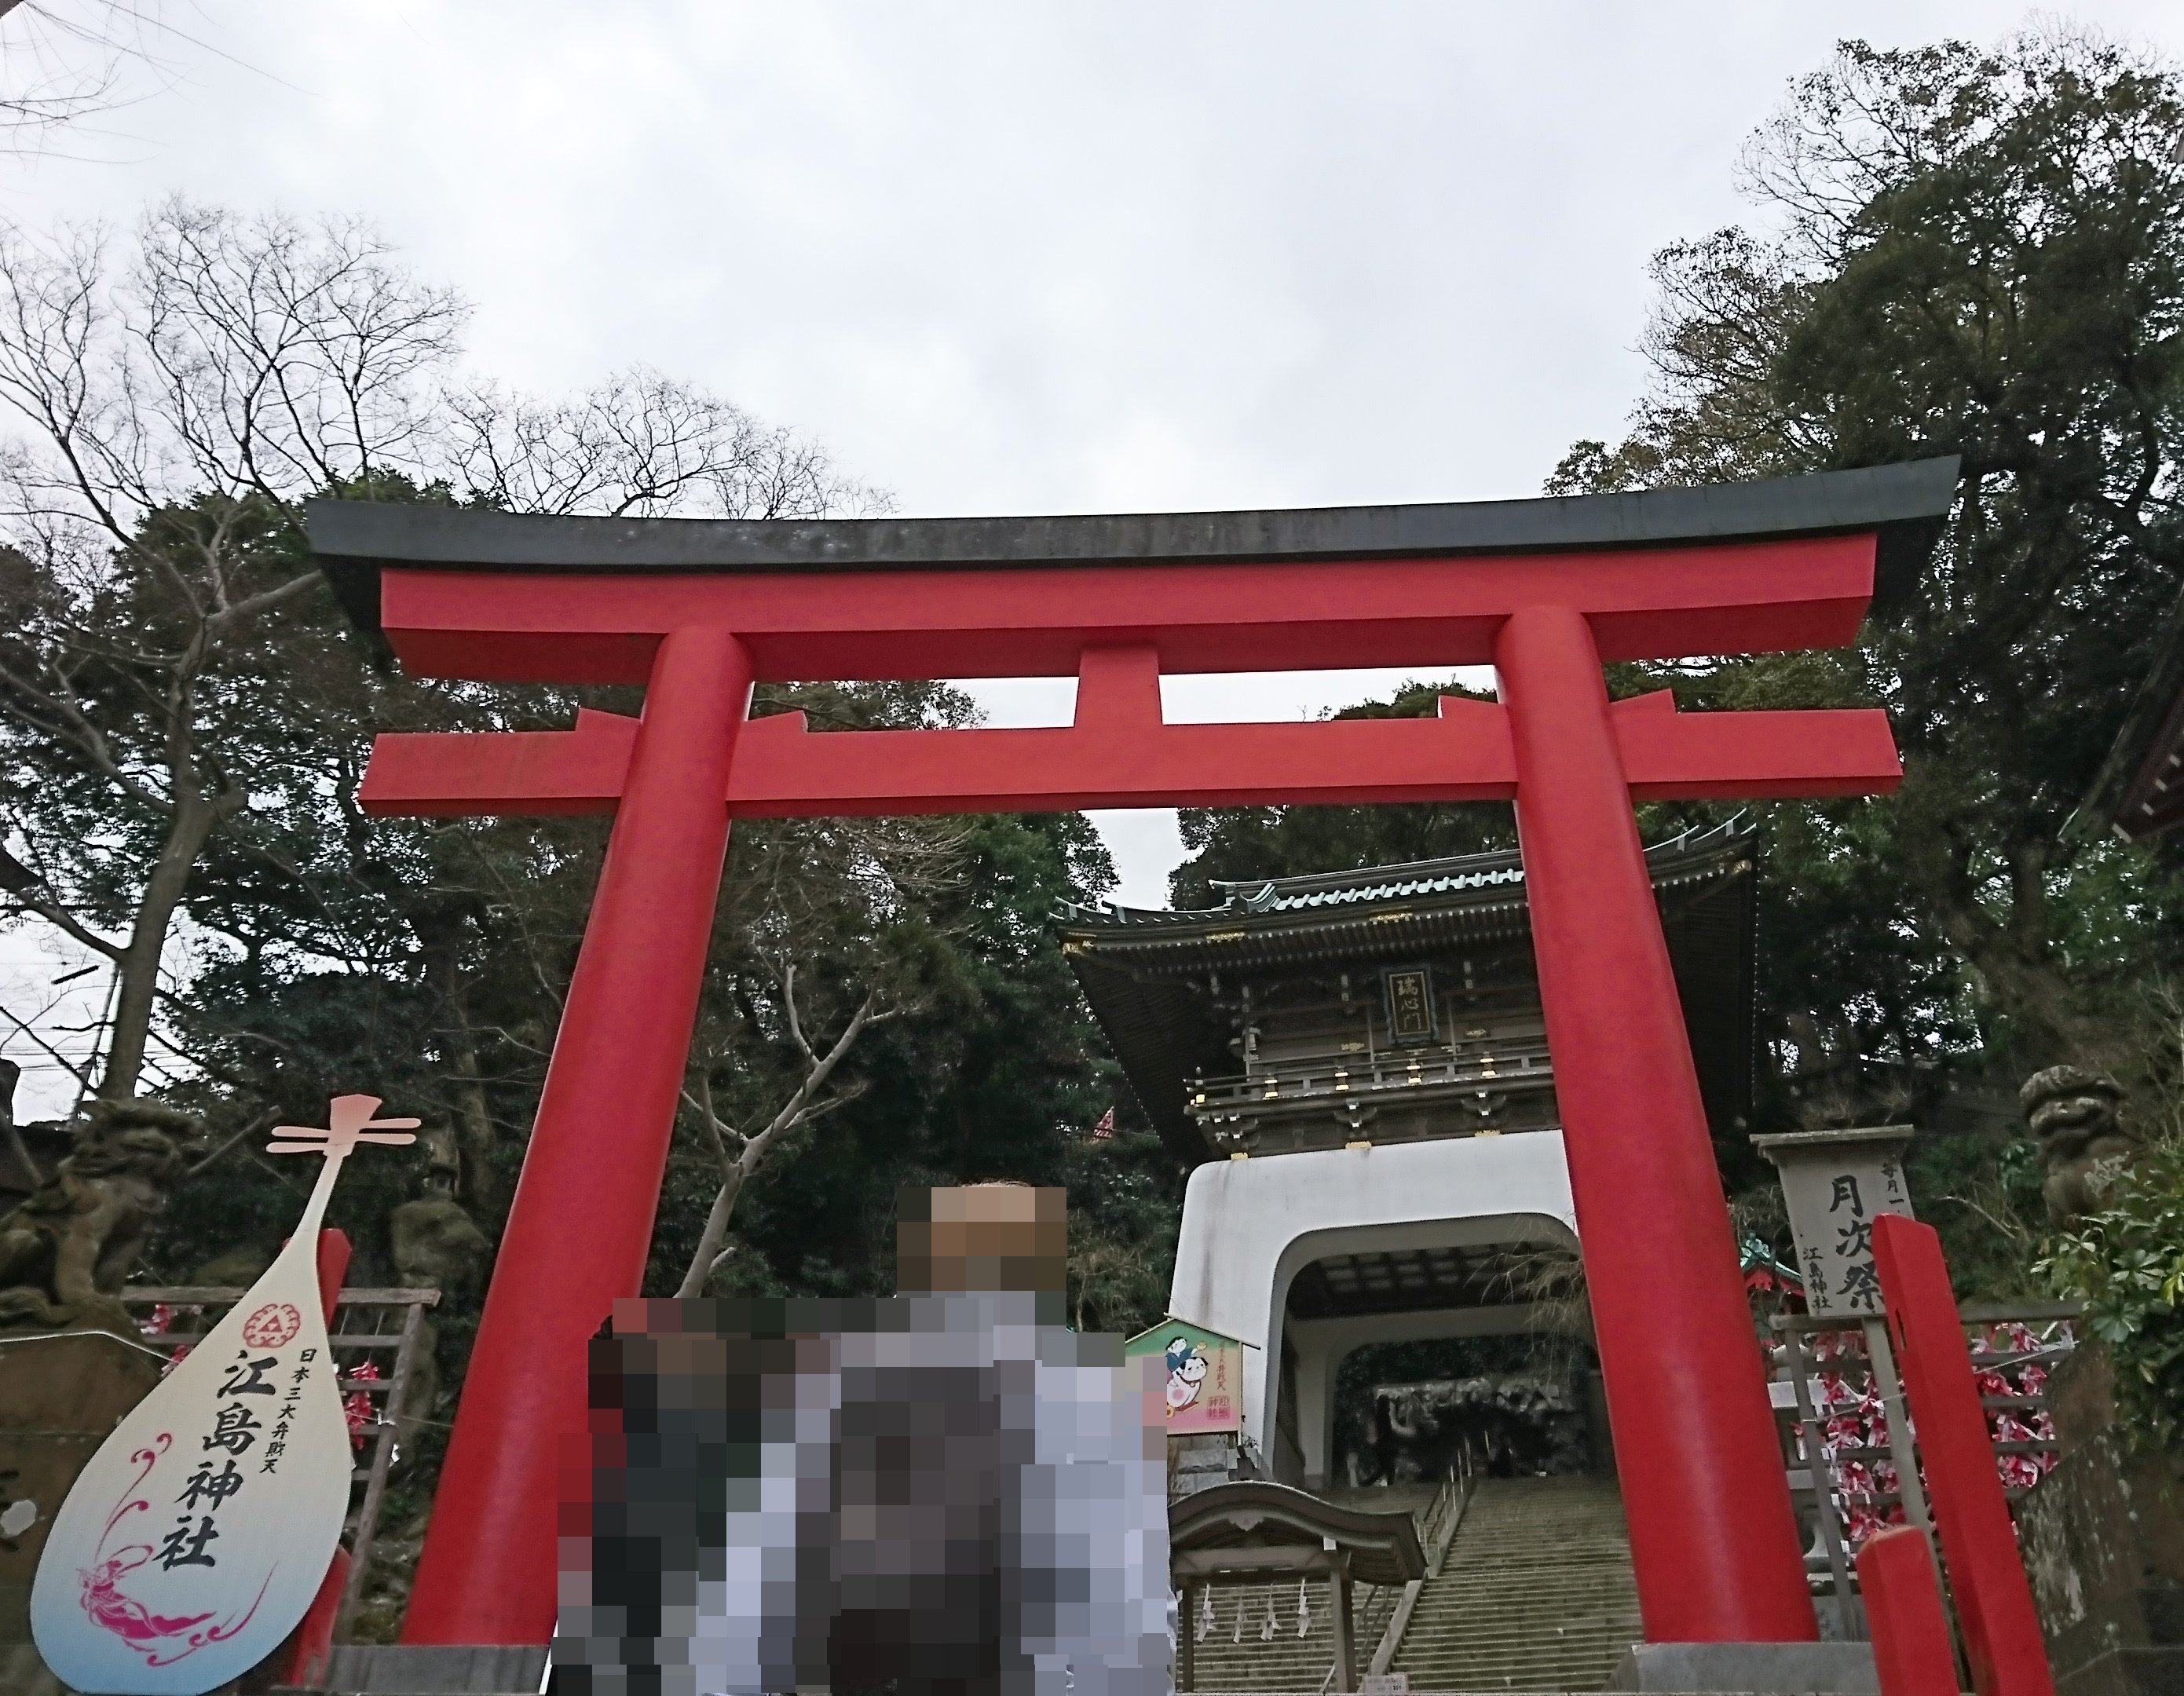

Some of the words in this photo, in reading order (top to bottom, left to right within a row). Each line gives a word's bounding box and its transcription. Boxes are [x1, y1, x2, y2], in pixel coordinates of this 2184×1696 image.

[1828, 1175, 1886, 1314] 月次祭
[1881, 1162, 1904, 1213] 毎月一
[1802, 1246, 1833, 1315] 江島神社
[152, 1349, 279, 1572] 江島神社
[259, 1347, 317, 1475] 日本三大弁財天
